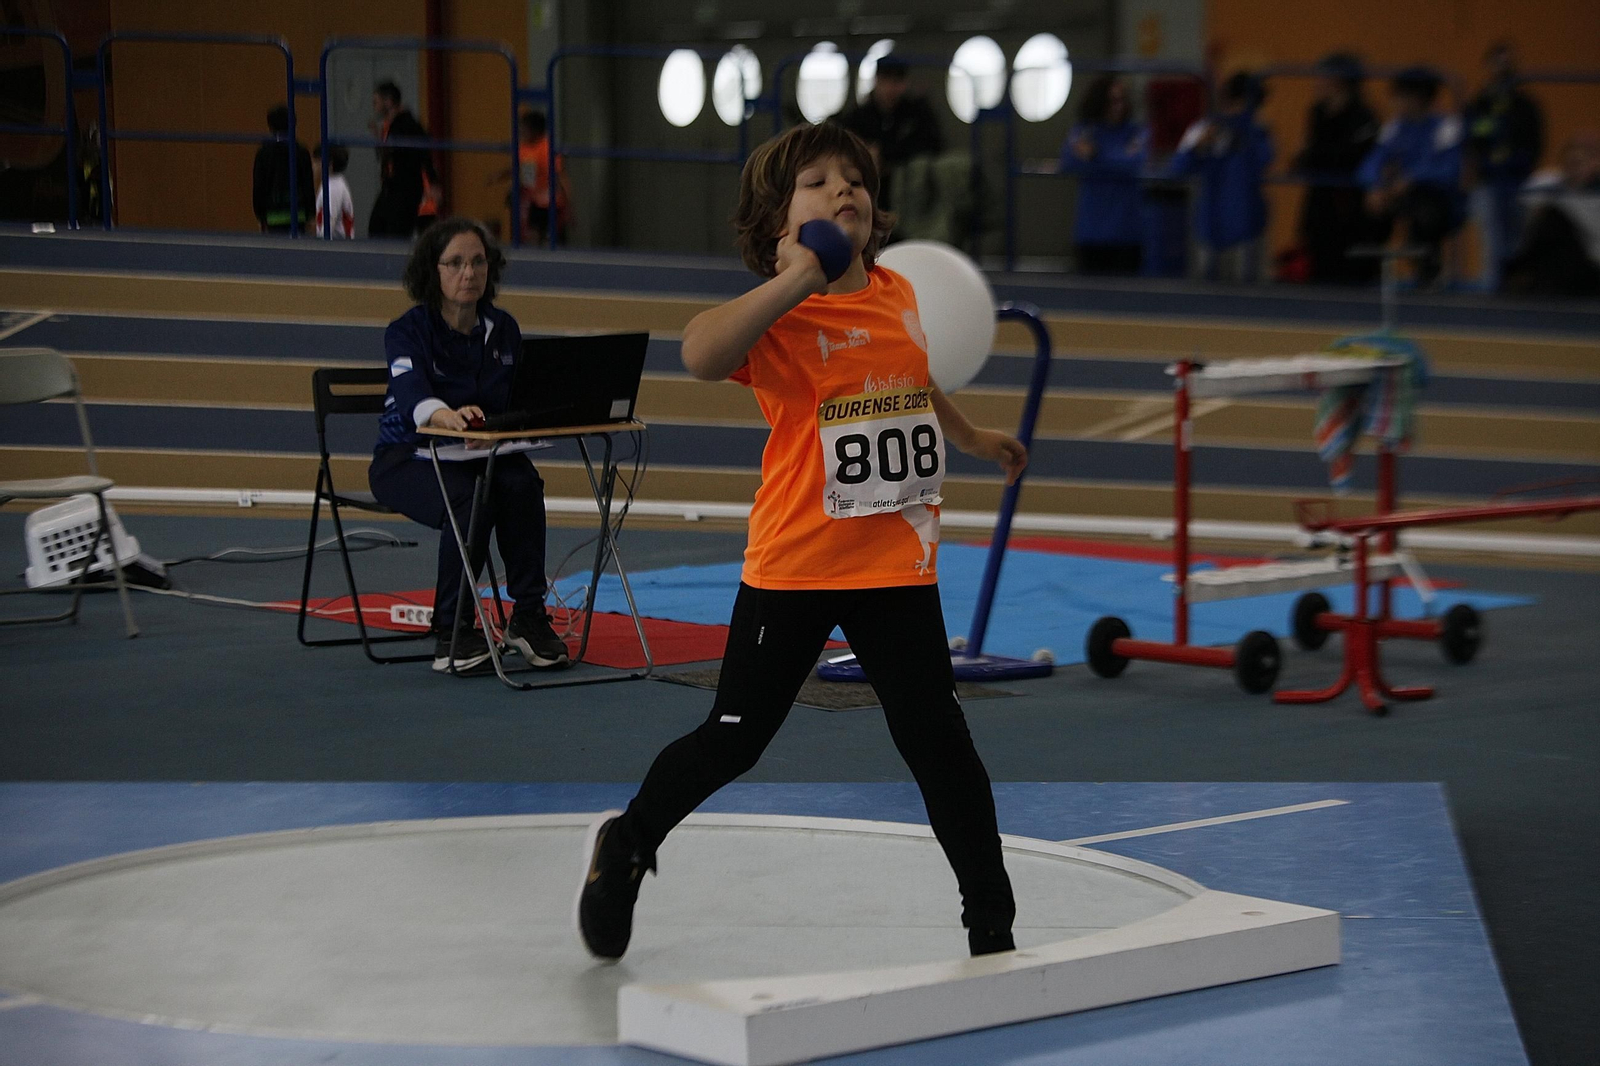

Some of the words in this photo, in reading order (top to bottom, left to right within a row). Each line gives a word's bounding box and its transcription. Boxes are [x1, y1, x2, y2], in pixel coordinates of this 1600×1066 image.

[824, 395, 900, 421] OURENSE
[904, 393, 928, 410] 2025
[834, 424, 939, 484] 808
